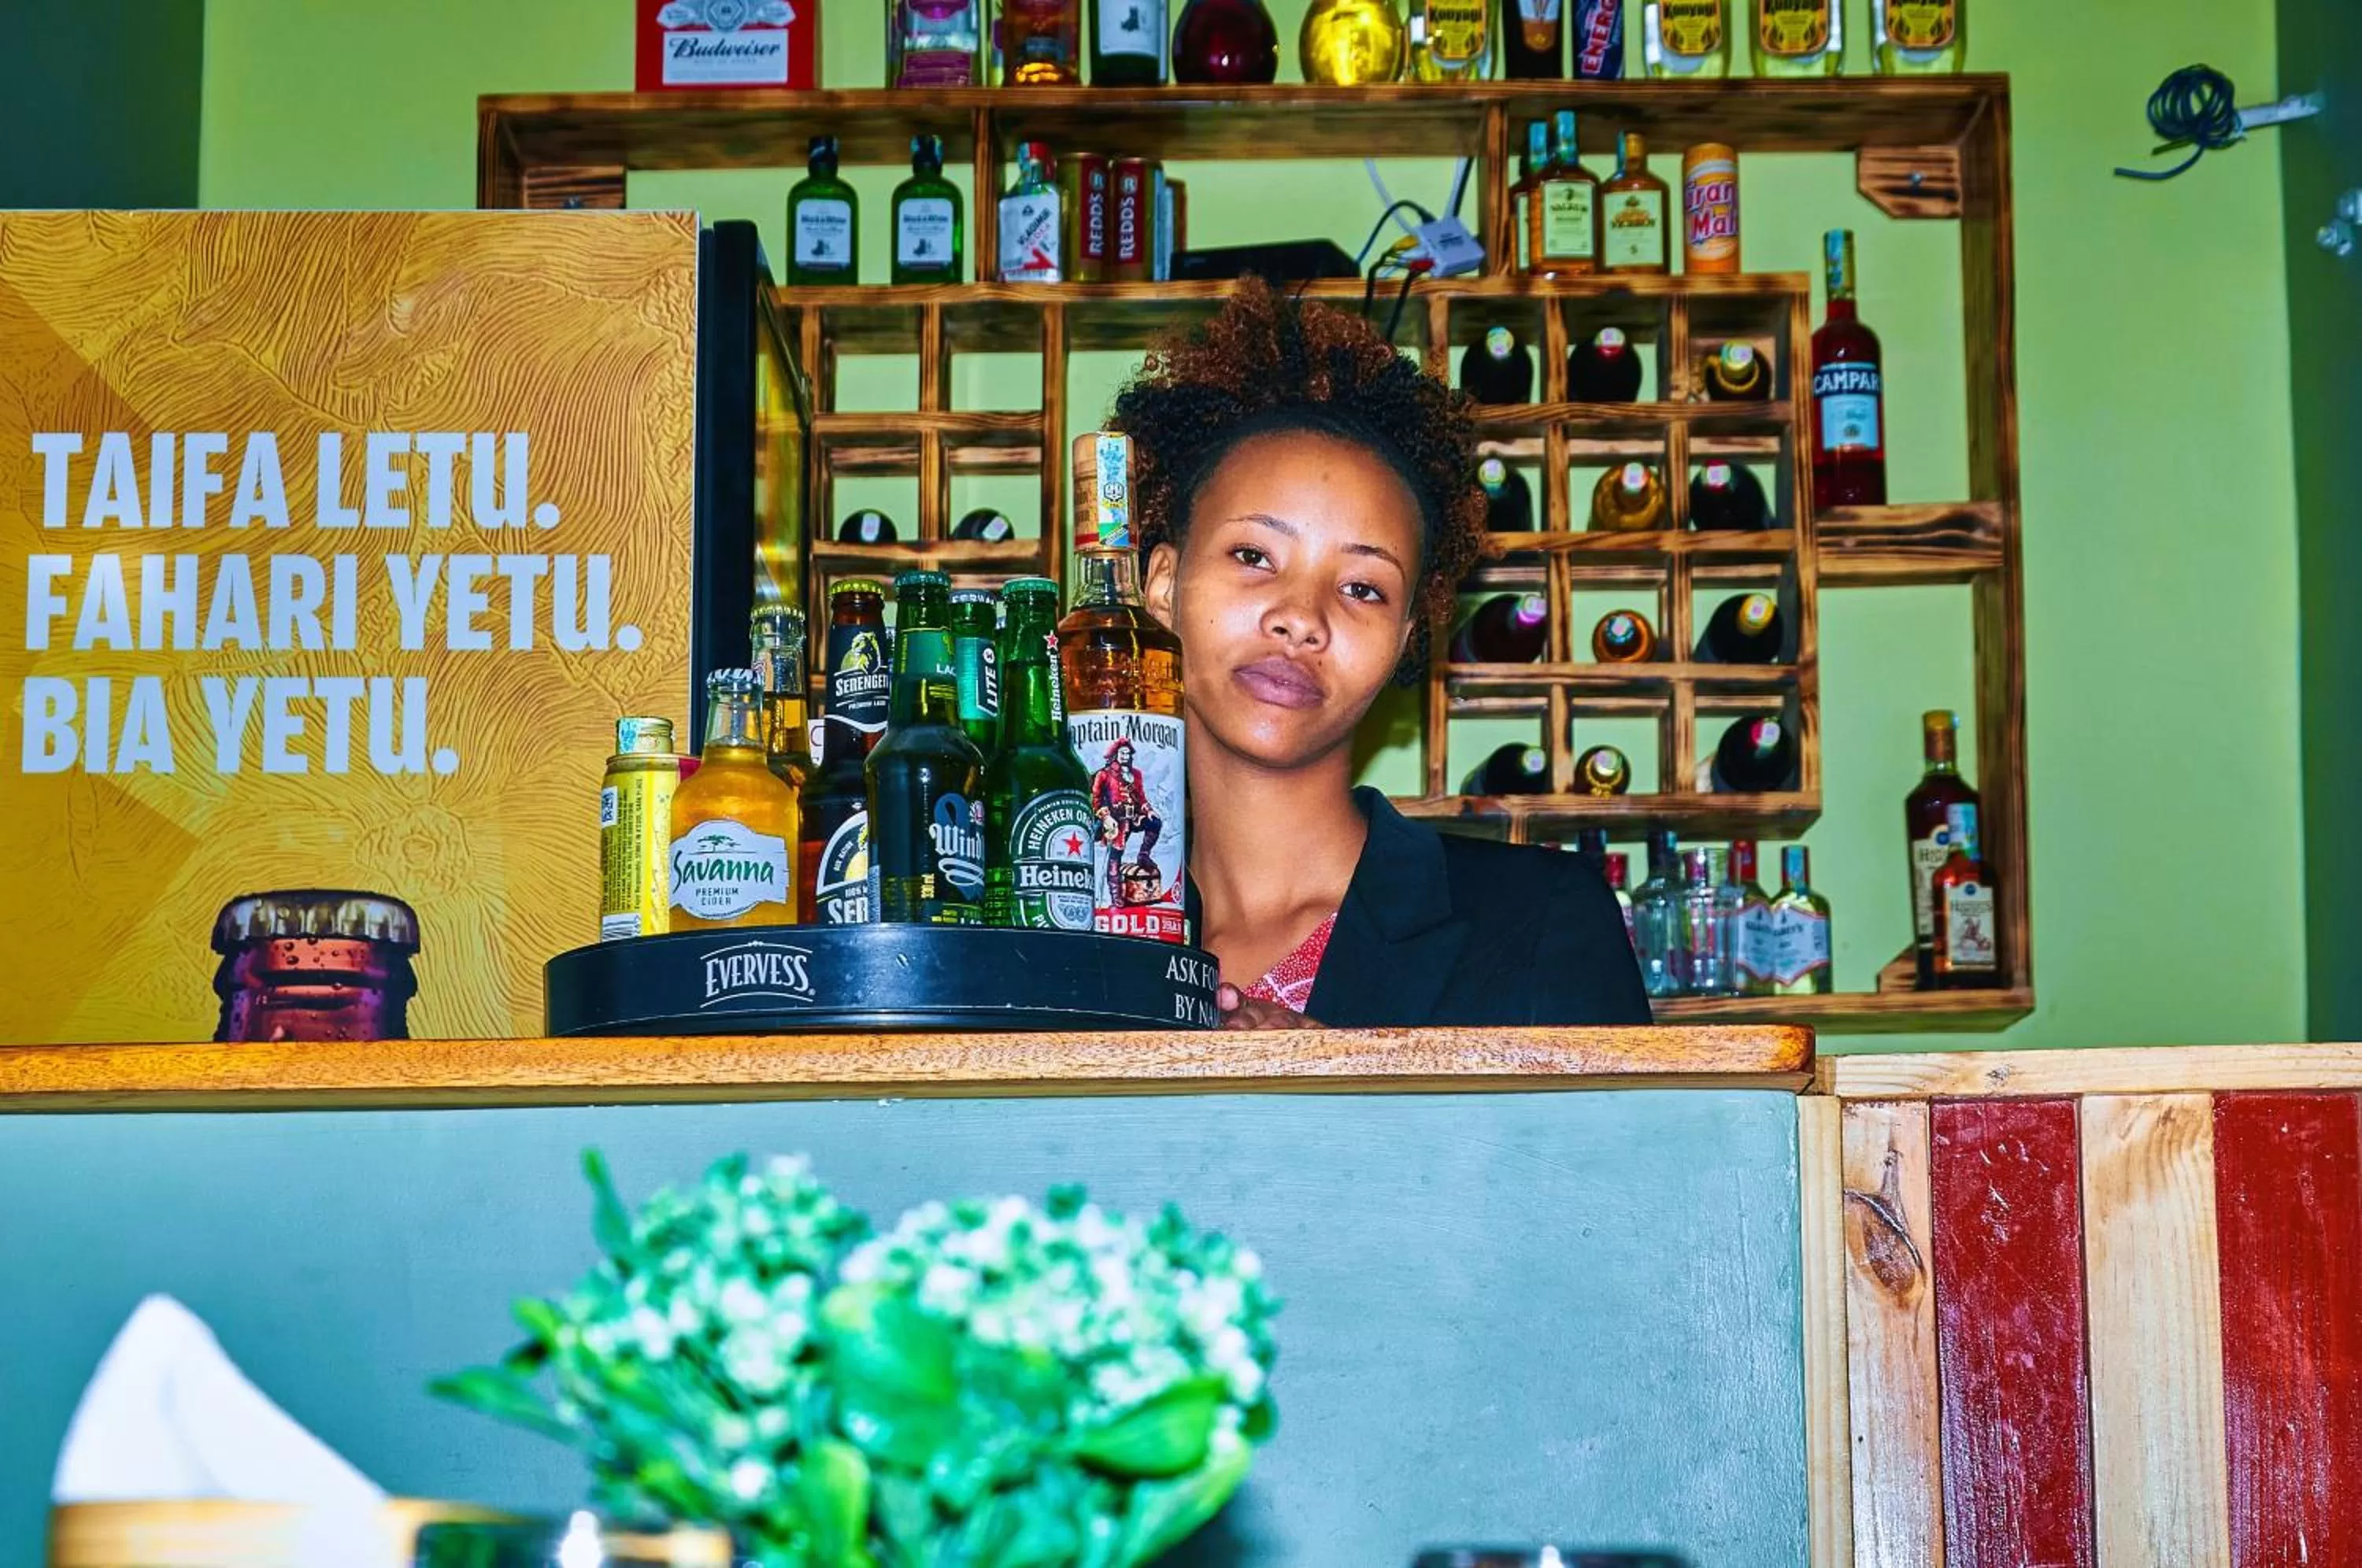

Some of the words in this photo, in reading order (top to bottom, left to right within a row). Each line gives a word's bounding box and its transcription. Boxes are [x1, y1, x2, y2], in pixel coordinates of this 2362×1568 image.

[670, 38, 780, 59] Budweiser
[1581, 0, 1616, 74] ENERG
[1813, 371, 1880, 394] CAMPAR
[32, 432, 290, 527] TAIFA
[317, 432, 560, 529] LETU.
[26, 554, 357, 650] FAHARI
[386, 554, 642, 651] YETU.
[985, 667, 998, 708] LITE
[1048, 654, 1062, 722] Heineken
[22, 676, 174, 773] BIA
[200, 676, 459, 775] YETU.
[1068, 716, 1120, 749] aptain
[1121, 715, 1179, 751] Morgan
[928, 823, 985, 860] Wind
[1027, 808, 1074, 850] HEINEKEN
[672, 850, 774, 894] Savanna
[1020, 865, 1094, 890] Heinek
[695, 887, 739, 897] PREMIUM
[701, 897, 731, 906] CIDER
[1094, 914, 1160, 934] GOLD
[705, 953, 809, 997] EVERVESS
[1165, 955, 1200, 986] ASK
[1175, 993, 1195, 1021] BY
